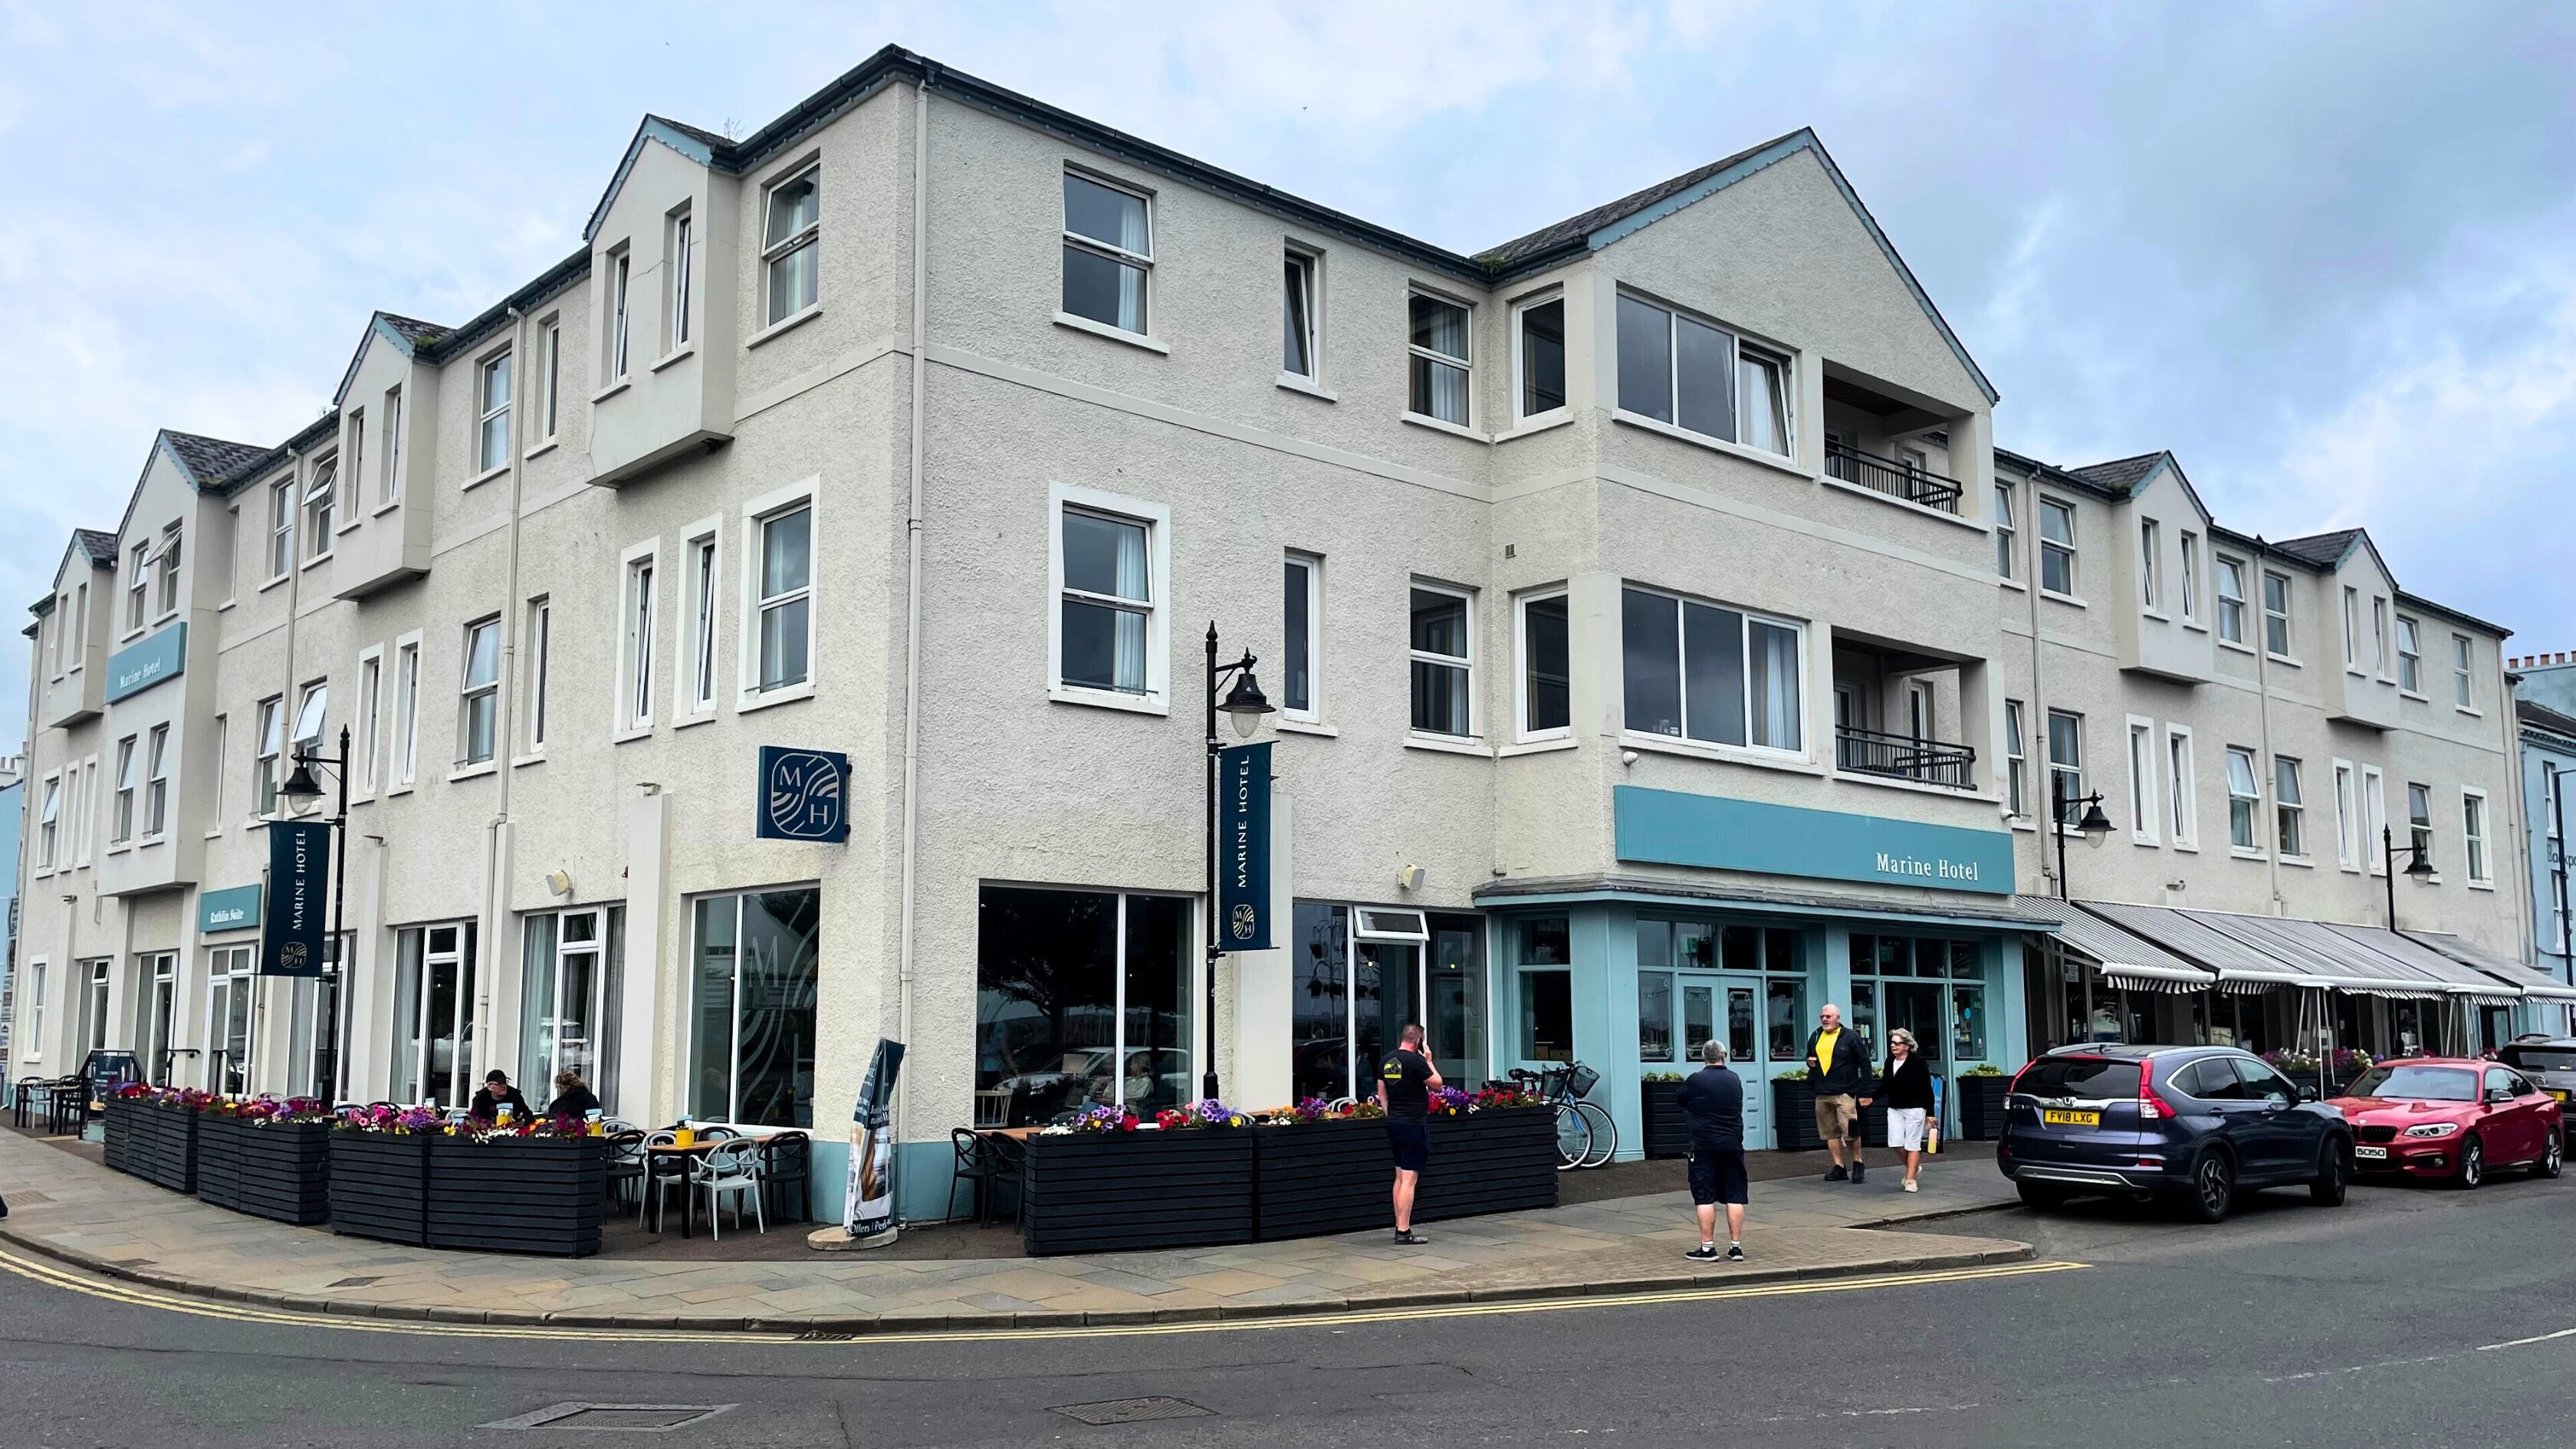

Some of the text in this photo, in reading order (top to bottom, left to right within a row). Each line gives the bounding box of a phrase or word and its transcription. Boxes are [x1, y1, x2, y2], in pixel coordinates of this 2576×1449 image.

[780, 765, 801, 787] M
[810, 803, 828, 825] H
[1238, 755, 1250, 888] MARINE HOTEL
[1876, 852, 1980, 881] Marine Hotel
[292, 830, 306, 930] MARINE HOTEL
[2050, 1112, 2093, 1123] FY18 LXG
